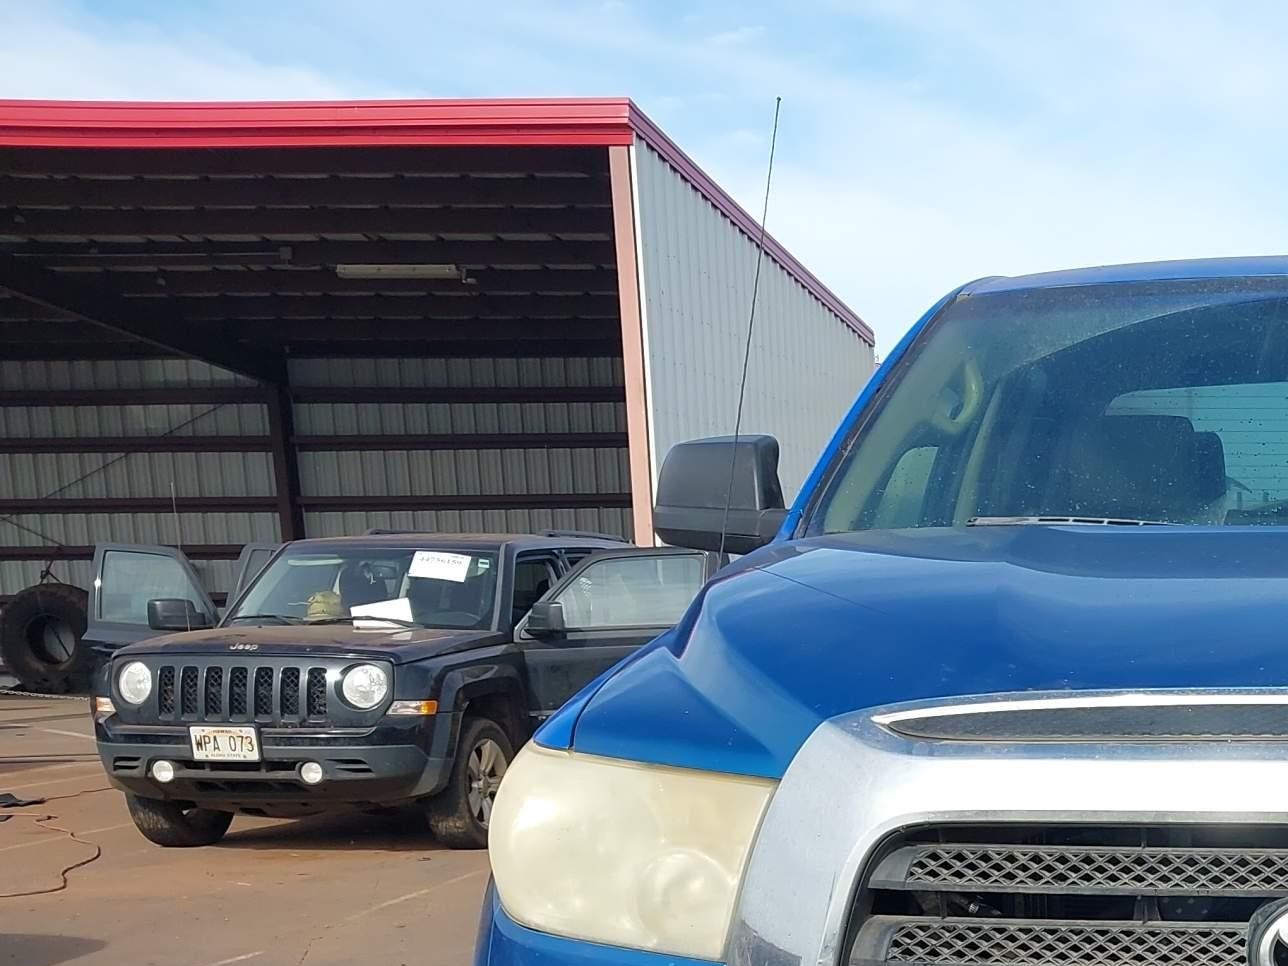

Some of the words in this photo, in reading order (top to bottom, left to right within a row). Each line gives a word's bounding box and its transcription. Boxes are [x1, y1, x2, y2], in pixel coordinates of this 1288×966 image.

[229, 642, 259, 651] Jeep
[194, 734, 221, 752] WPA
[228, 735, 255, 752] 073
